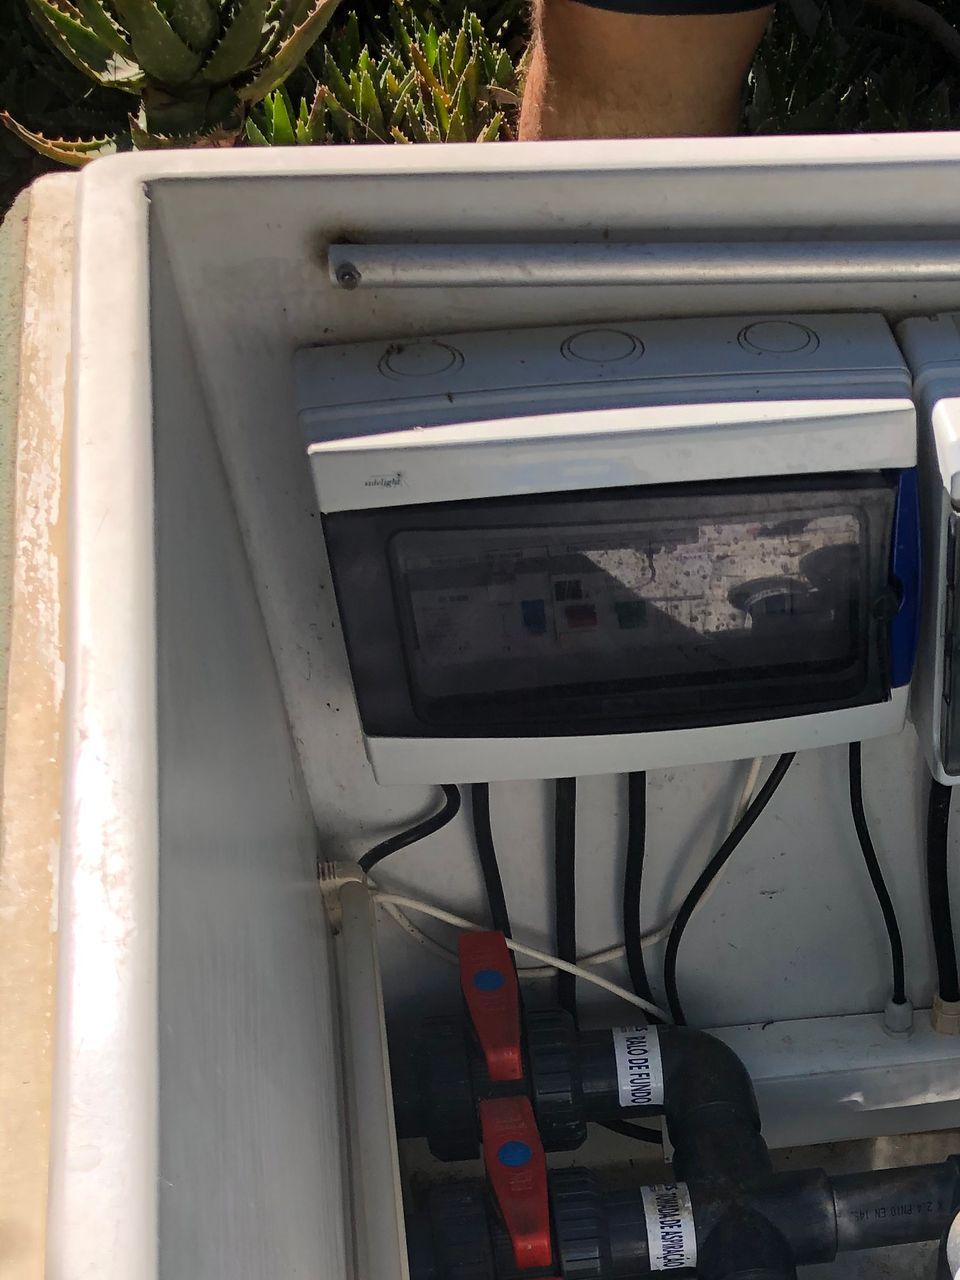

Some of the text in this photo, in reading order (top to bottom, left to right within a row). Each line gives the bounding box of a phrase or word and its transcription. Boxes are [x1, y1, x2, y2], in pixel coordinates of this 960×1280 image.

[625, 1035, 648, 1056] RALO
[628, 1058, 649, 1070] DE
[630, 1073, 652, 1104] FUNDO
[659, 1220, 682, 1230] DE
